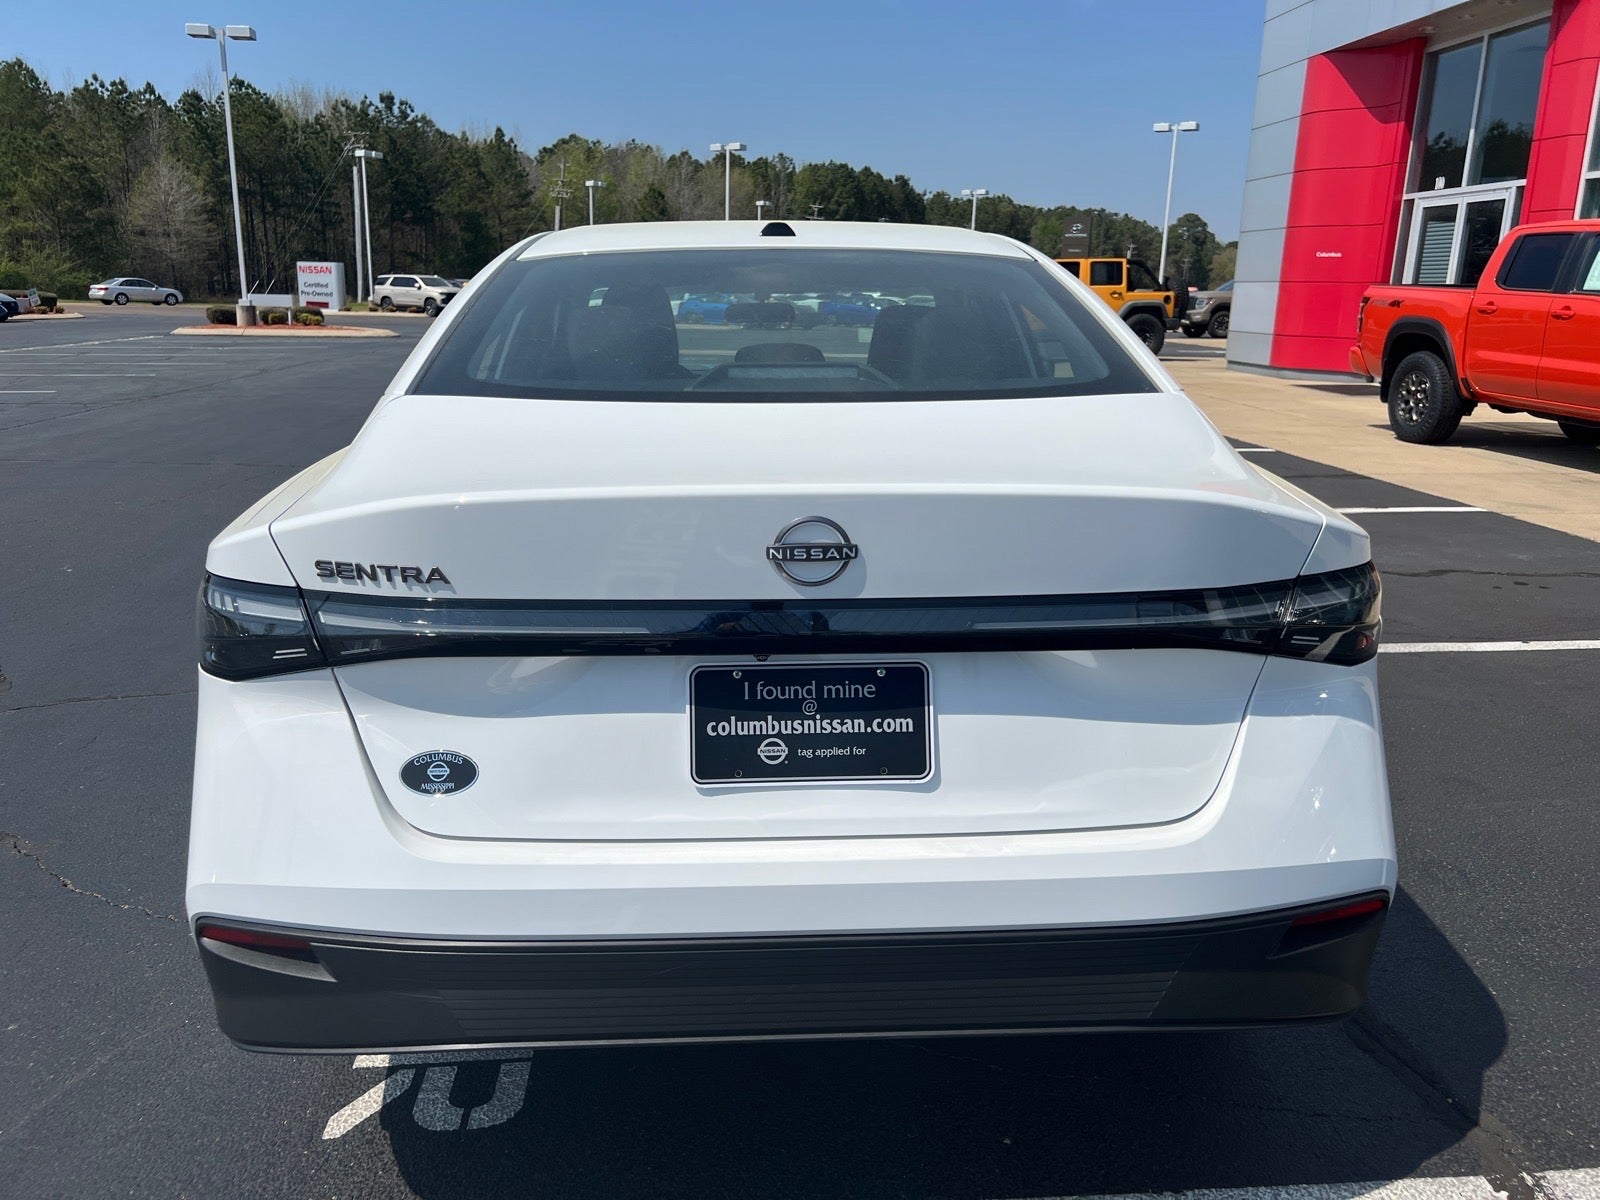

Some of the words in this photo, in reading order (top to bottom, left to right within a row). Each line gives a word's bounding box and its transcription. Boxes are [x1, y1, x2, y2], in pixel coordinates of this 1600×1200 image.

[298, 265, 332, 275] NISSAN
[303, 281, 329, 289] Certified
[300, 290, 334, 298] Pre-Owned
[769, 547, 856, 560] NISSAN
[314, 559, 451, 585] SENTRA
[743, 681, 750, 700] I
[756, 680, 817, 700] found
[823, 680, 877, 699] mine
[802, 699, 818, 716] @
[706, 714, 914, 736] columbusnissan.com
[760, 747, 786, 755] NISSAN
[797, 748, 814, 759] tag
[815, 746, 850, 758] applied
[852, 745, 867, 756] for
[413, 753, 464, 766] COLUMBUS
